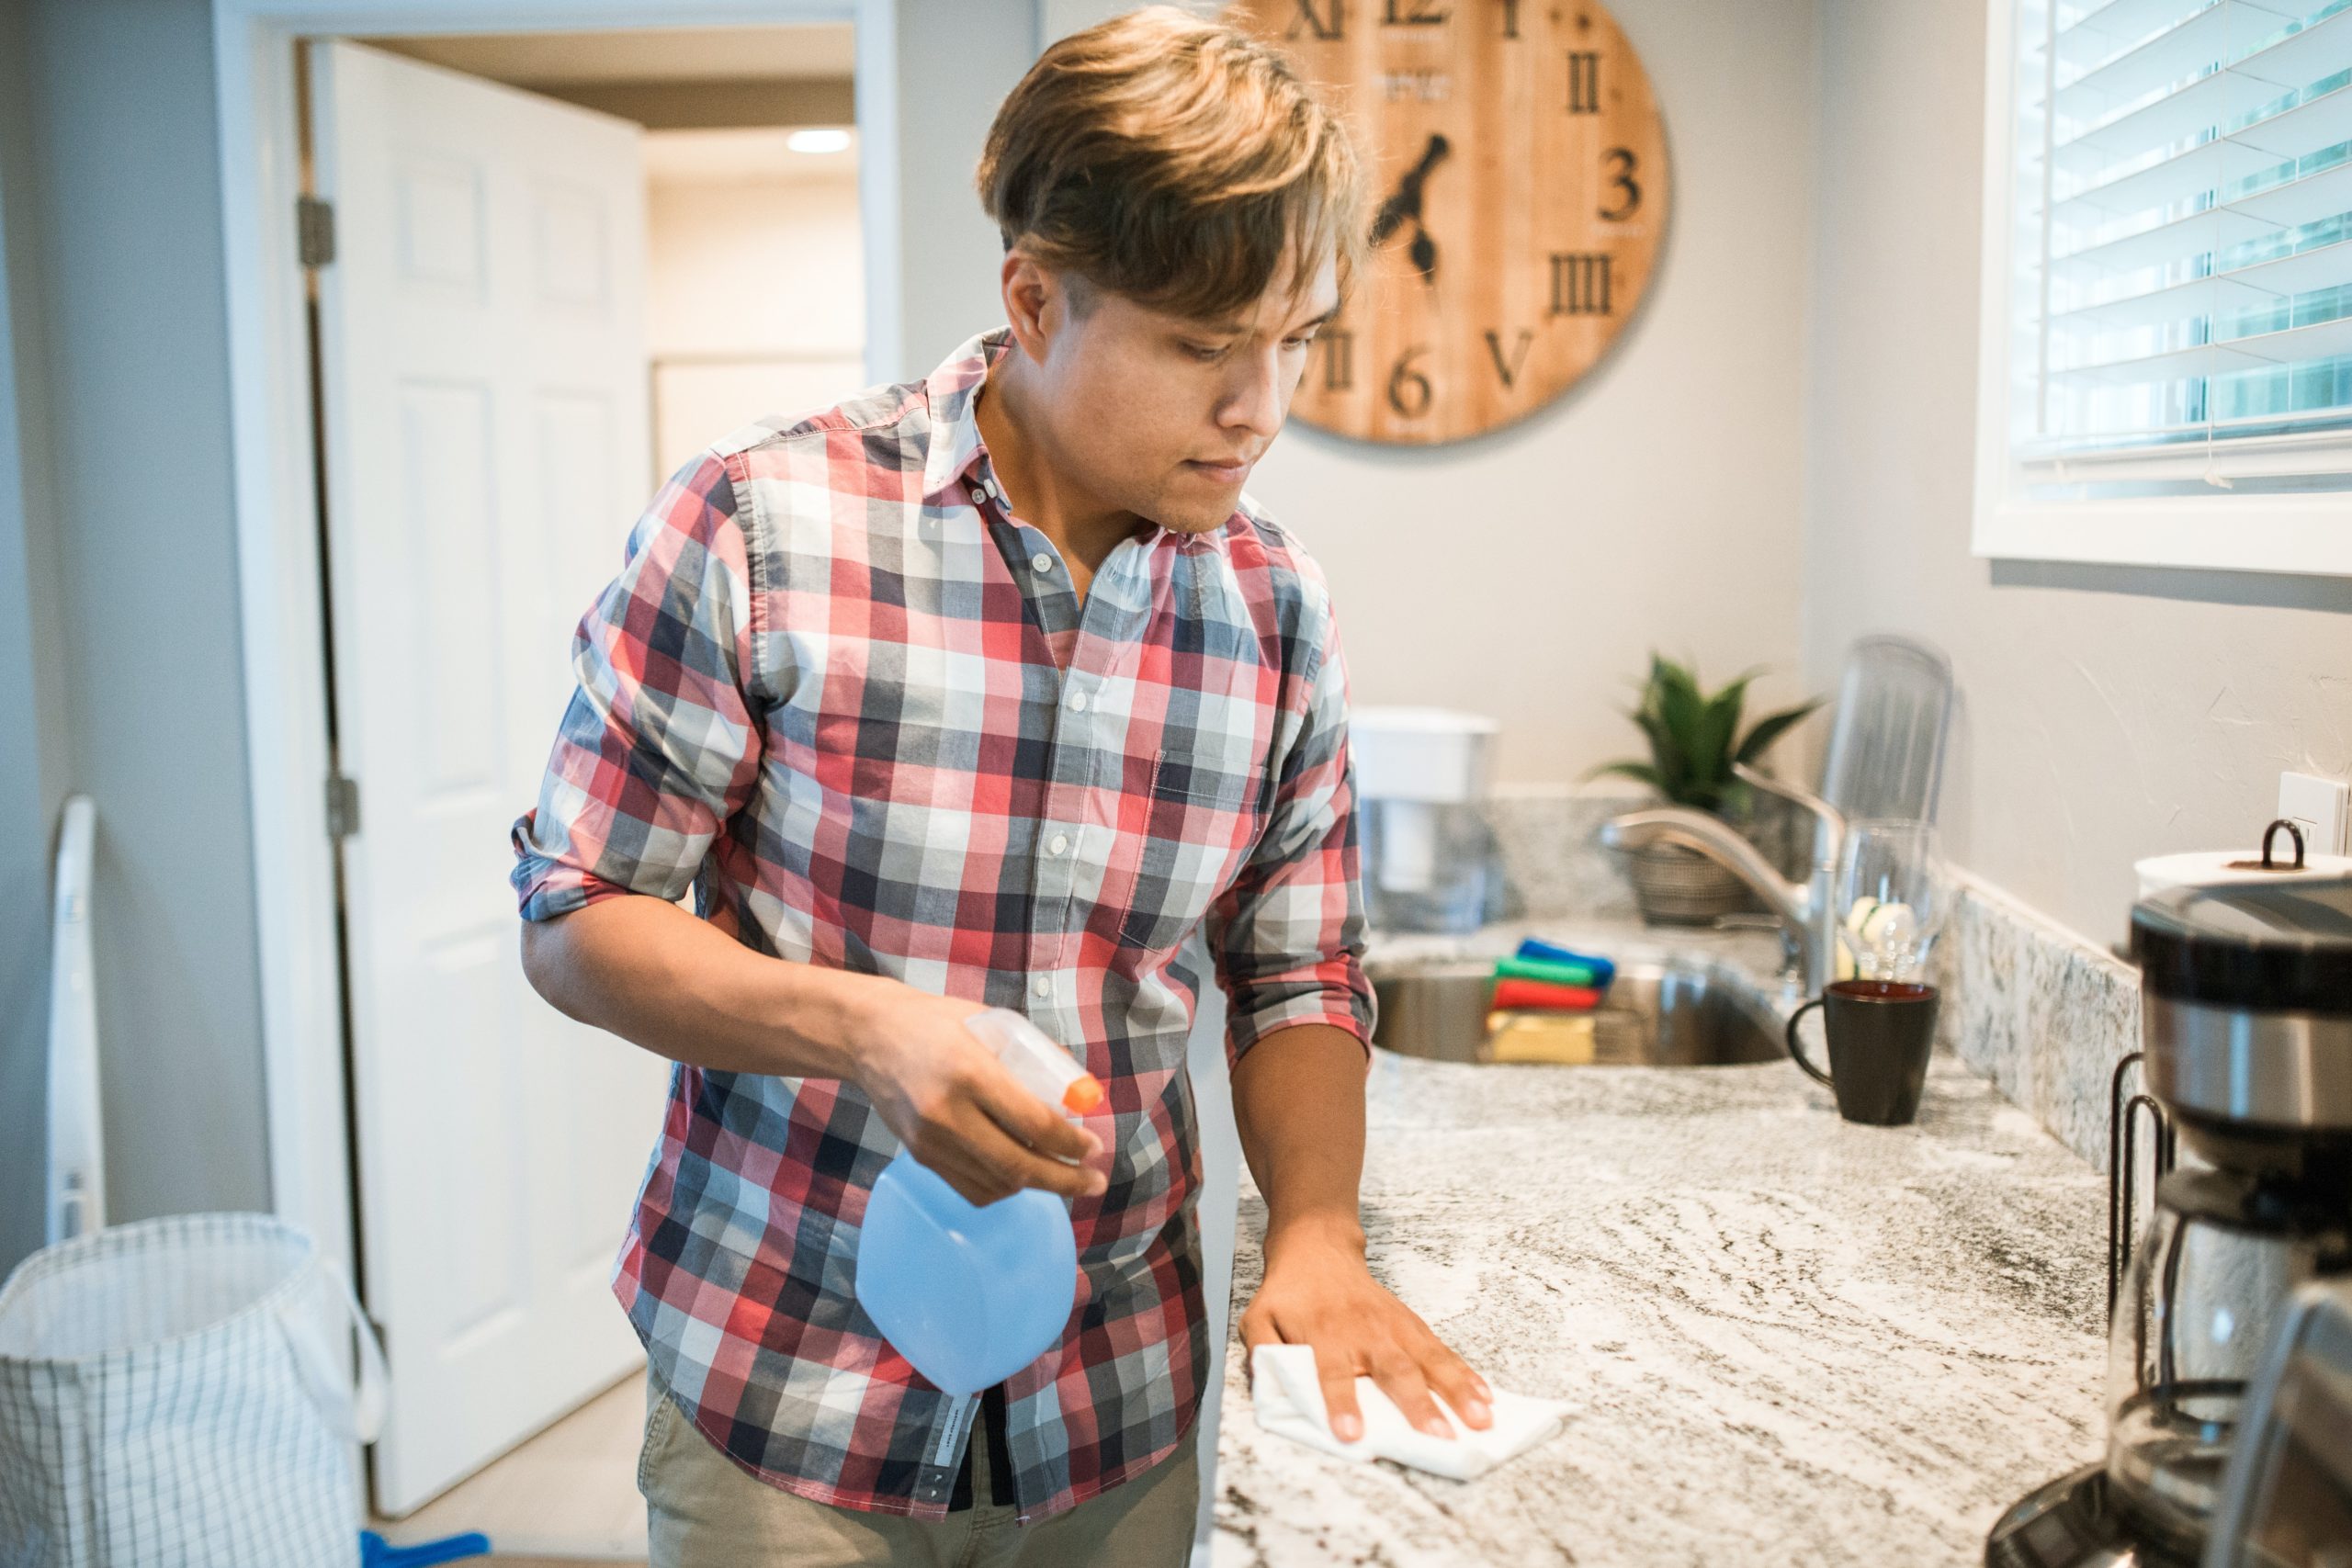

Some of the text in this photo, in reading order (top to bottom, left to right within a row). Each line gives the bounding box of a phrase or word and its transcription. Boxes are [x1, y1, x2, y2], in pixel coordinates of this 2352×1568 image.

[1566, 51, 1600, 114] II
[1598, 147, 1643, 221] 3
[1549, 253, 1613, 315] IIII
[1389, 344, 1431, 418] 6
[1485, 329, 1533, 389] V
